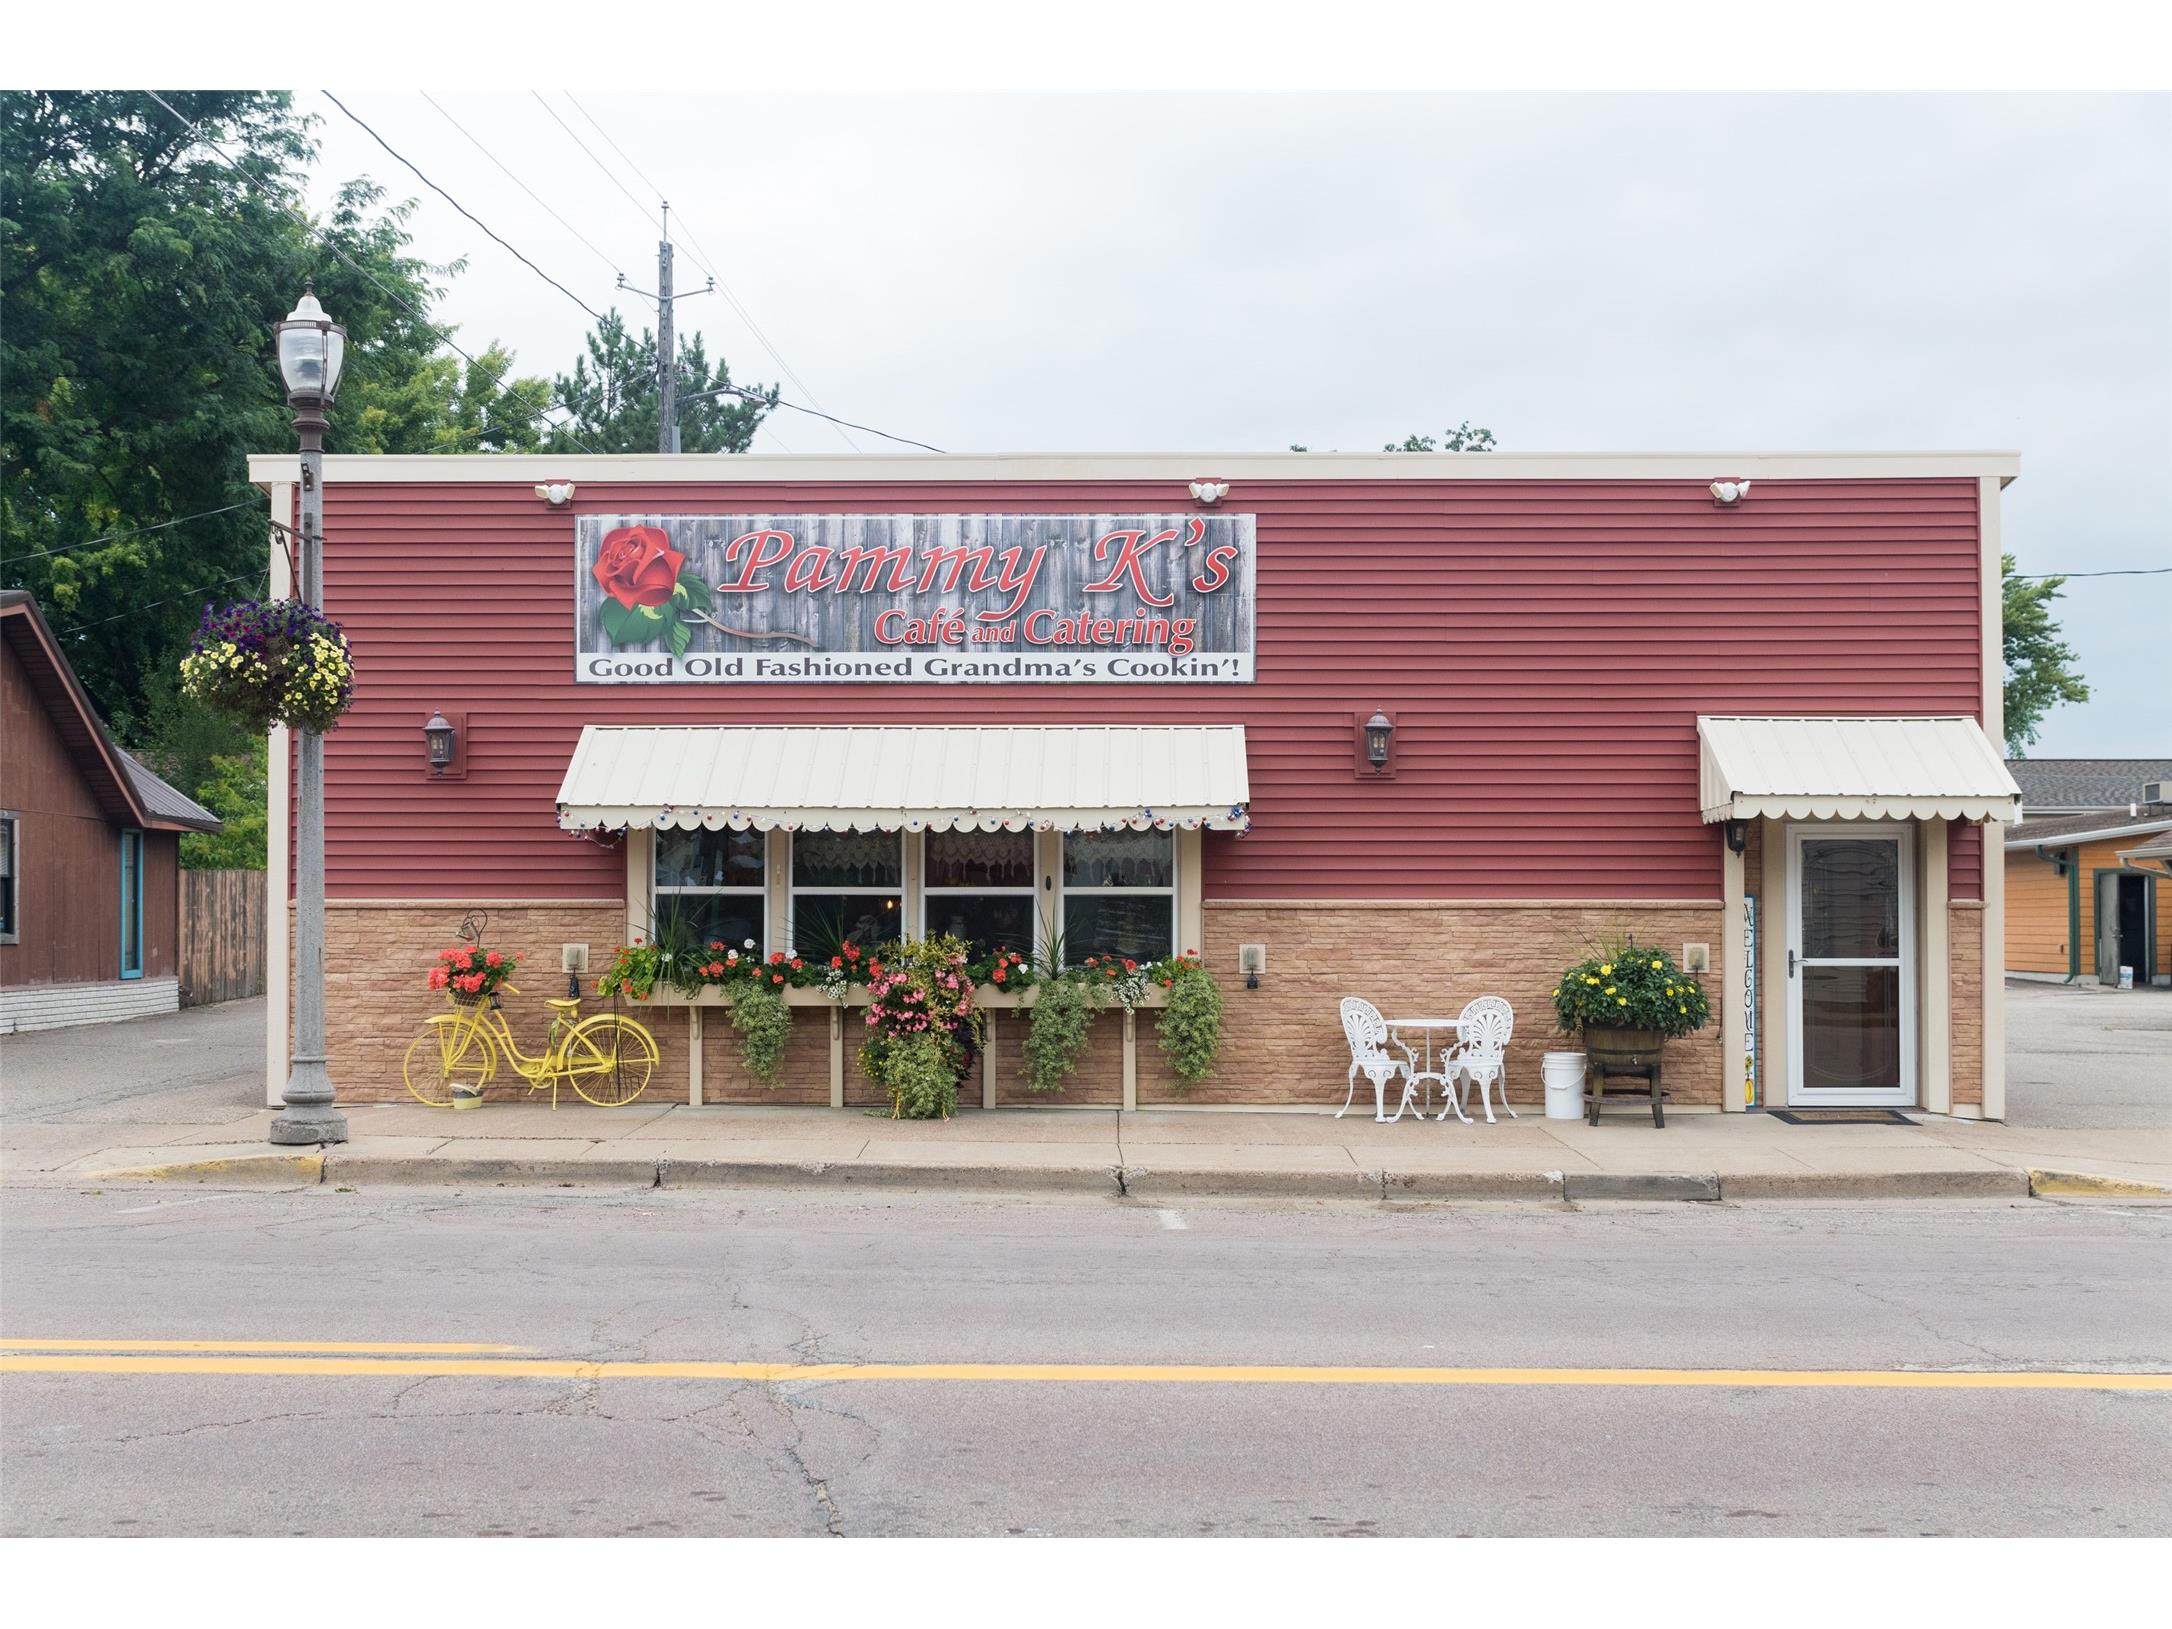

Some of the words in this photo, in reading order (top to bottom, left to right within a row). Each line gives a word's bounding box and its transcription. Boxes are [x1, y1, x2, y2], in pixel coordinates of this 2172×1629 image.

[717, 528, 1049, 622] Pammy
[1082, 515, 1238, 606] K's
[873, 606, 965, 645] Café
[970, 619, 1017, 644] and
[1022, 608, 1196, 657] Catering
[589, 657, 674, 677] Good
[684, 657, 744, 677] Old
[756, 657, 912, 677] Fashioned
[924, 657, 1097, 677] Grandma's
[1107, 657, 1240, 677] Cookin'!
